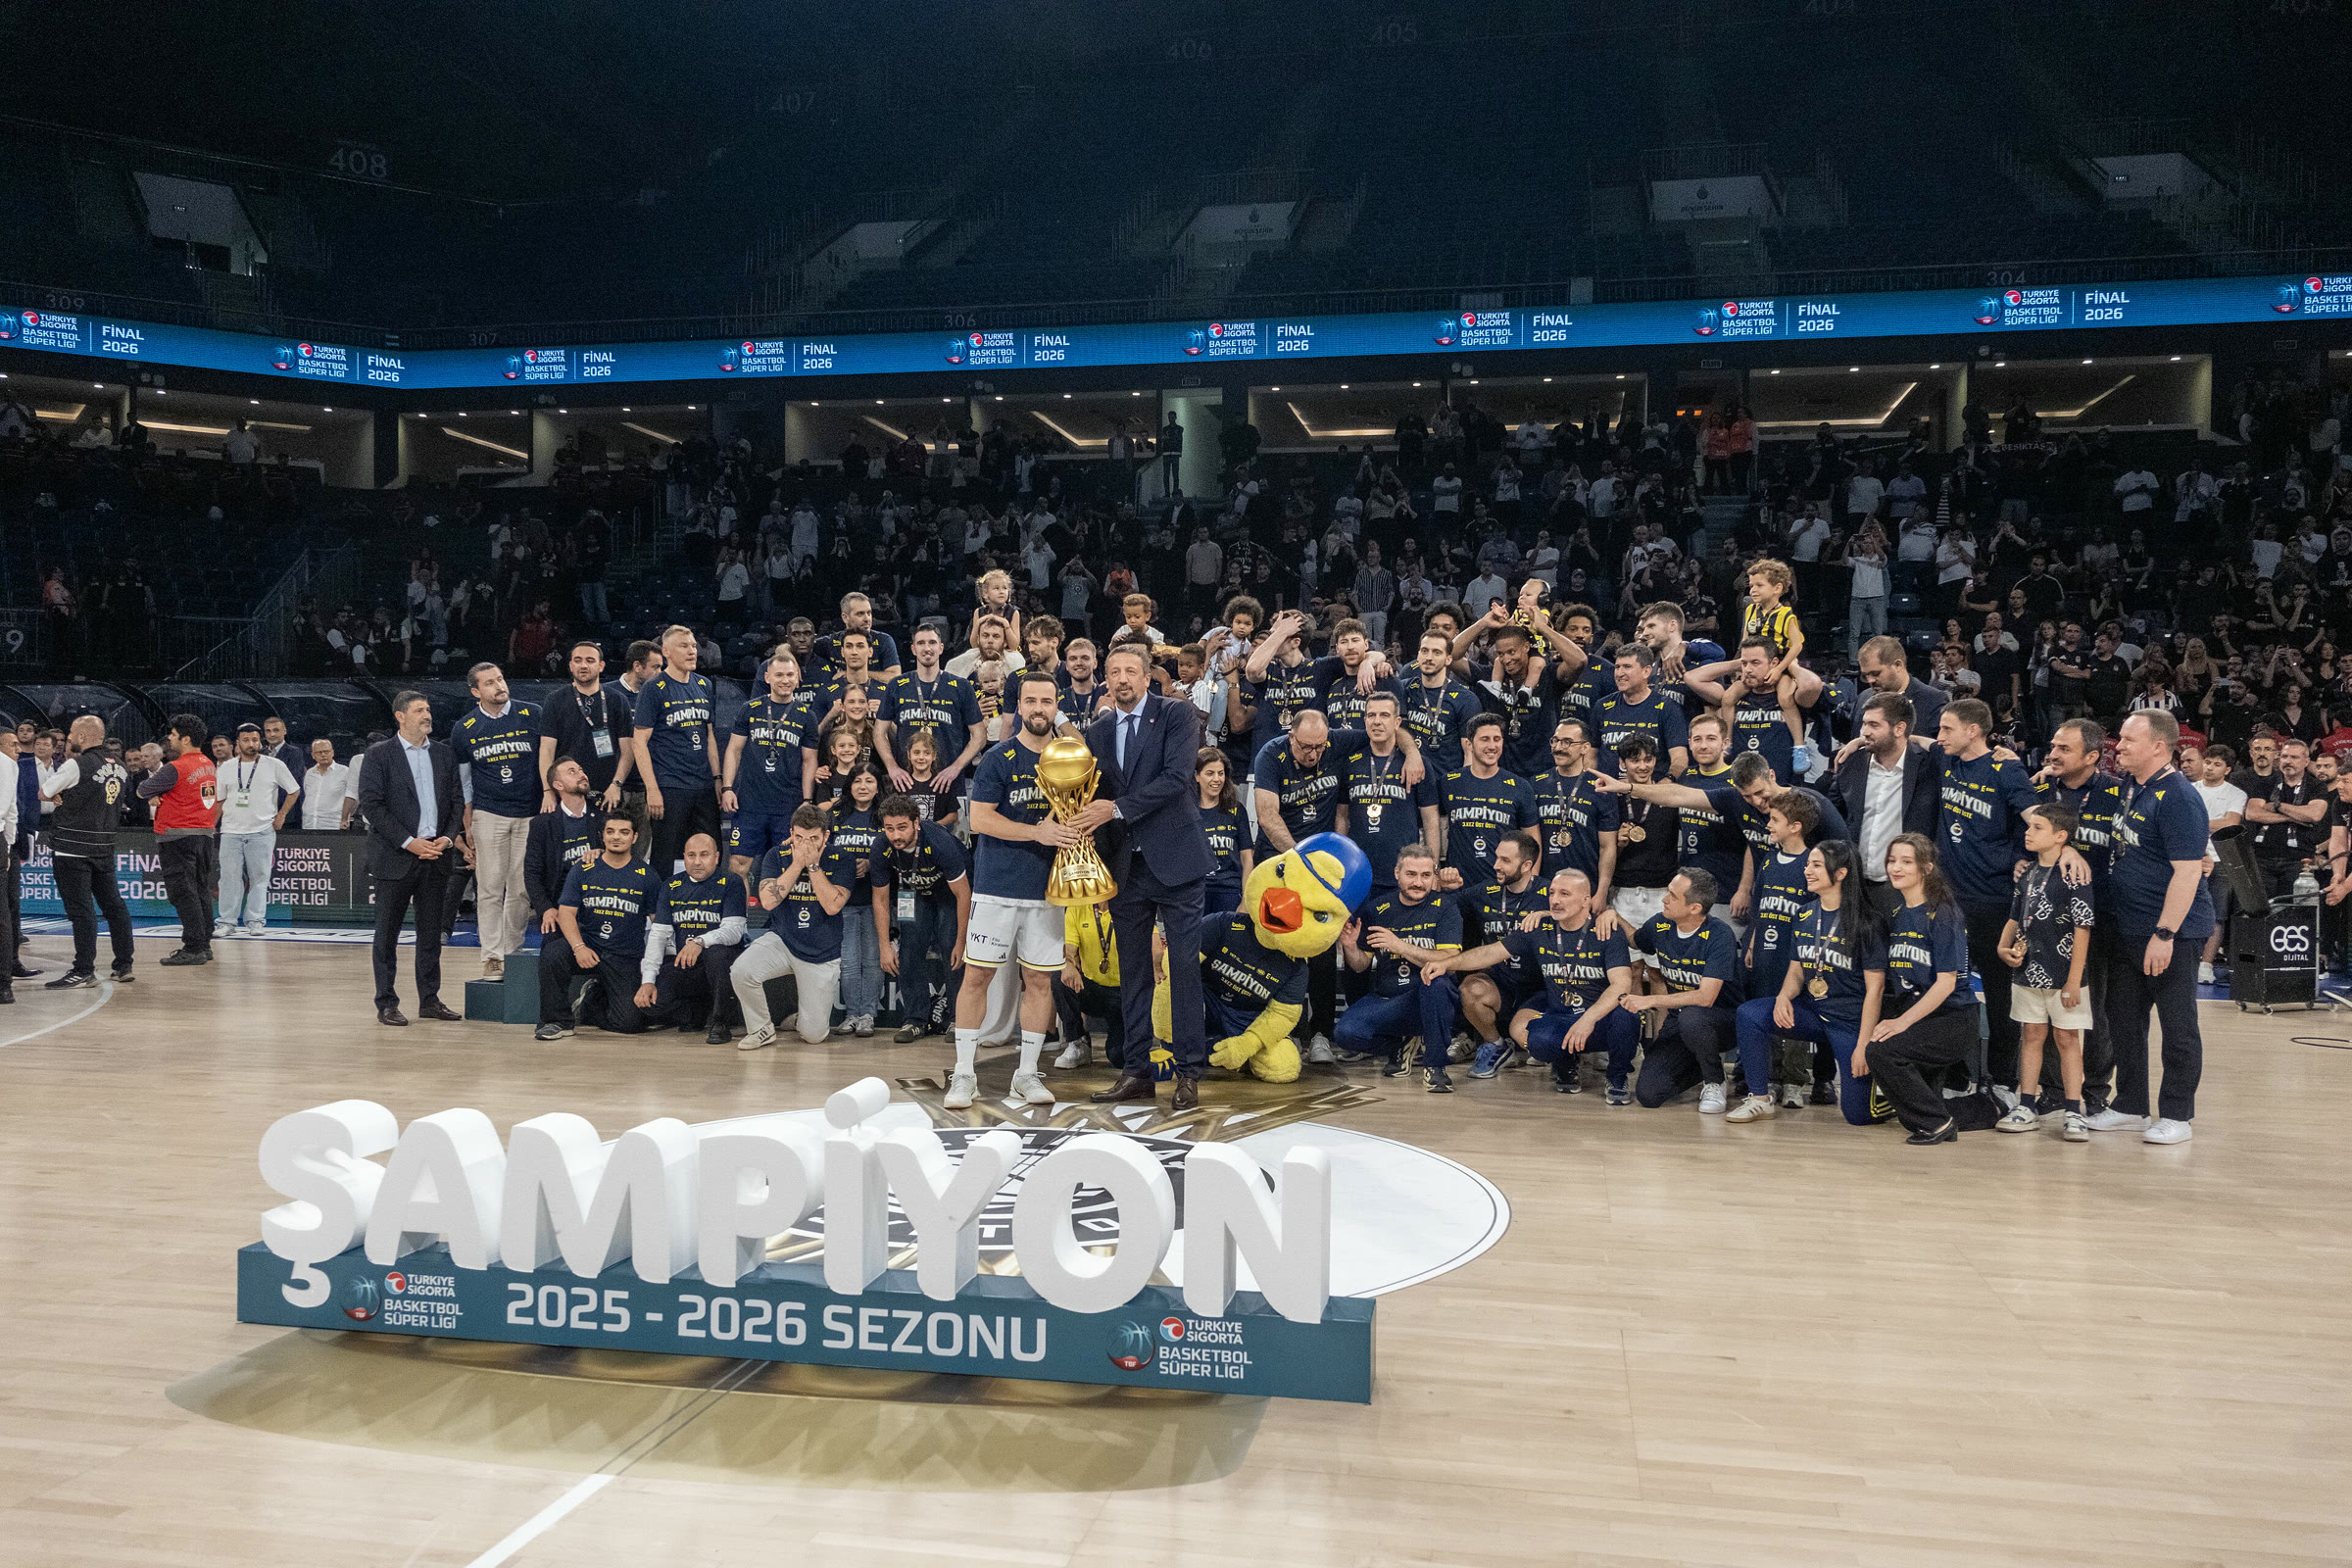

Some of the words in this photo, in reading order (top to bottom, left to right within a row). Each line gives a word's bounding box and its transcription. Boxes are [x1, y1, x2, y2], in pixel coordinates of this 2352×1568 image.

[329, 148, 387, 178] 408
[1986, 270, 2026, 287] 304
[2084, 289, 2130, 305] FİNAL
[1797, 302, 1840, 317] FİNAL
[2004, 306, 2063, 317] BASKETBOL
[2084, 307, 2124, 321] 2026
[2304, 303, 2340, 314] SÜPER
[1533, 313, 1572, 326] FİNAL
[1722, 318, 1778, 327] BASKETBOL
[1797, 318, 1835, 332] 2026
[2004, 315, 2037, 325] SÜPER
[23, 327, 81, 341] BASKETBOL
[102, 324, 145, 340] FİNAL
[1277, 323, 1314, 337] FİNAL
[1461, 327, 1513, 337] BASKETBOL
[1533, 329, 1567, 342] 2026
[1722, 326, 1753, 336] SÜPER
[23, 335, 56, 347] SÜPER
[1034, 333, 1070, 347] FİNAL
[1209, 338, 1258, 348] BASKETBOL
[1277, 339, 1309, 352] 2026
[1461, 335, 1490, 346] SÜPER
[102, 340, 138, 354] 2026
[803, 343, 837, 355] FİNAL
[969, 348, 1016, 358] BASKETBOL
[1208, 346, 1237, 357] SÜPER
[368, 355, 405, 369] FİNAL
[583, 351, 615, 363] FİNAL
[969, 356, 996, 366] SÜPER
[1034, 349, 1065, 362] 2026
[298, 359, 349, 370] BASKETBOL
[524, 365, 567, 373] BASKETBOL
[742, 364, 767, 372] SÜPER
[803, 358, 833, 369] 2026
[298, 366, 327, 376] SÜPER
[368, 369, 400, 382] 2026
[524, 371, 549, 380] SÜPER
[583, 366, 612, 377] 2026
[472, 740, 532, 761] ŞAMPİYON
[1450, 805, 1511, 825] ŞAMPİYON
[275, 848, 330, 859] TÜRKİYE
[117, 849, 163, 872] FİNA
[276, 859, 331, 872] SİGORTA
[117, 880, 169, 901] 2026
[267, 877, 336, 891] ASKETBOL
[302, 891, 328, 906] LİGİ
[582, 896, 640, 914] ŞAMPİYON
[970, 931, 988, 944] YKT
[1210, 958, 1271, 1001] ŞAMPİYON
[259, 1076, 1331, 1324] ŞAMPİYON
[407, 1274, 455, 1287] TÜRKİYE
[407, 1285, 456, 1298] SİGORTA
[384, 1298, 464, 1315] BASKETBOL
[384, 1313, 428, 1328] SÜPER
[431, 1315, 456, 1329] LİGİ
[507, 1283, 632, 1333] 2025
[677, 1295, 808, 1346] 2026
[821, 1303, 1047, 1363] SEZONU
[1186, 1319, 1243, 1333] TÜRKİYE
[1186, 1332, 1244, 1346] SİGORTA
[1159, 1347, 1252, 1364] BASKETBOL
[1158, 1360, 1211, 1377] SÜPER
[1214, 1363, 1244, 1380] LİGİ
